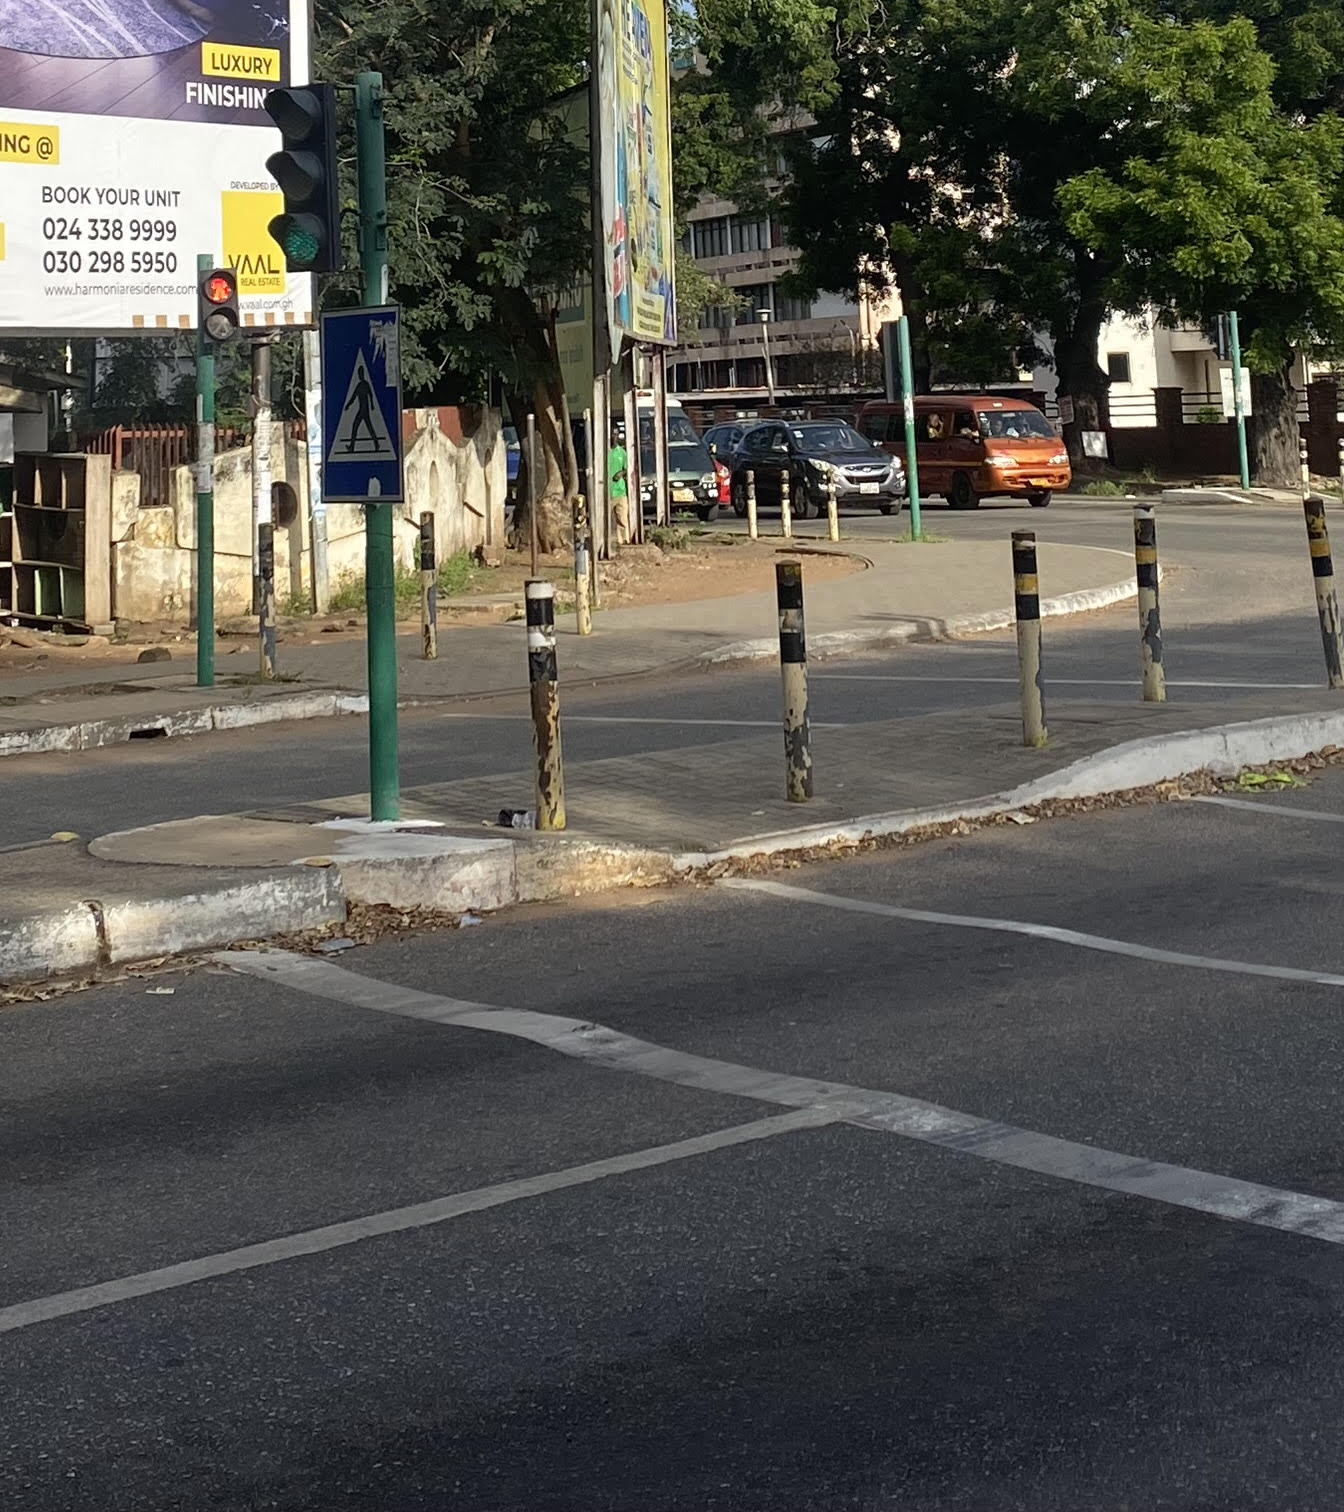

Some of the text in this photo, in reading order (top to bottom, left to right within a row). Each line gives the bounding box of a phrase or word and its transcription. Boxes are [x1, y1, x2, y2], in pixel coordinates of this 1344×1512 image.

[211, 52, 273, 75] LUXURY
[185, 81, 275, 110] FINISHIN
[35, 136, 54, 160] @
[41, 185, 181, 208] BOOK YOUR UNIT
[230, 180, 269, 191] DEVELOPED
[42, 217, 177, 242] 024 338 9999
[43, 250, 178, 273] 030 298 5950
[44, 282, 198, 297] www.harmoniaresidence.com
[240, 277, 281, 287] REAL ESTATE
